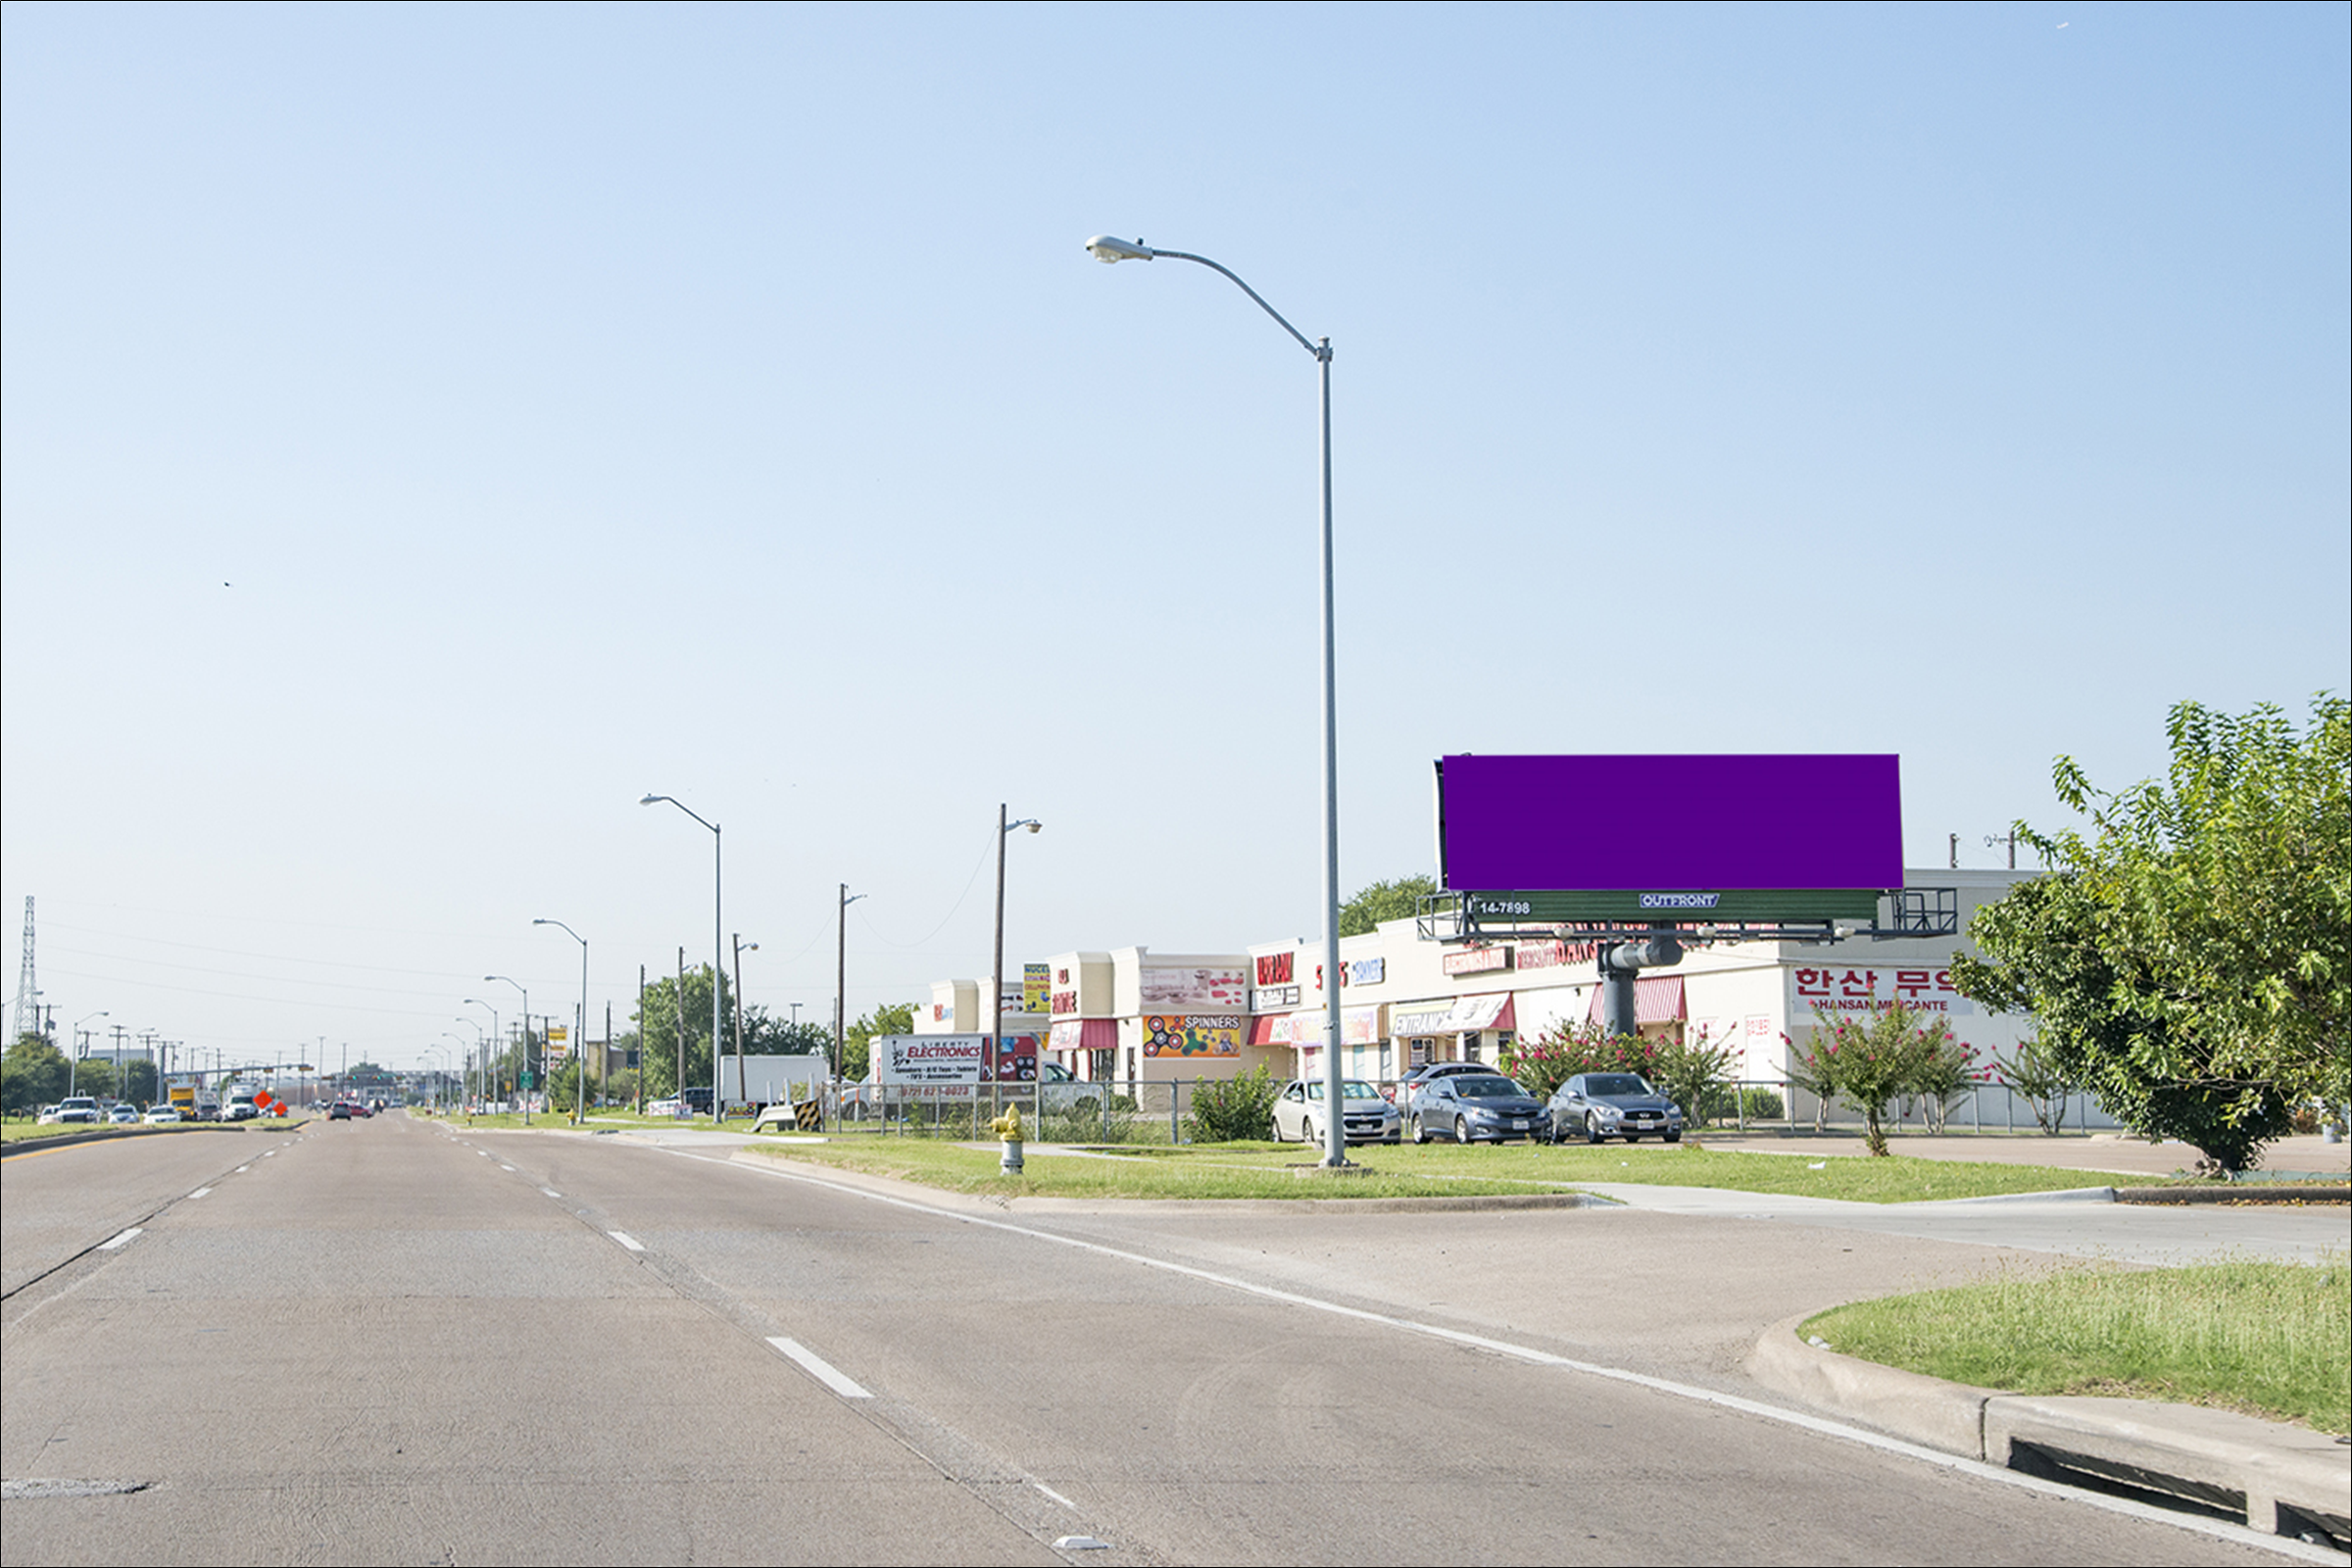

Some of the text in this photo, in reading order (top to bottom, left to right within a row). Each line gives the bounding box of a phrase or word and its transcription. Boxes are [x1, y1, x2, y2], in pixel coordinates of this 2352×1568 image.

[1480, 902, 1531, 914] 14-7898
[1794, 968, 1879, 997] 한산
[1819, 1000, 1873, 1010] HANSAN
[1185, 1015, 1240, 1030] SPINNERS
[907, 1046, 981, 1058] ELECTRONICS
